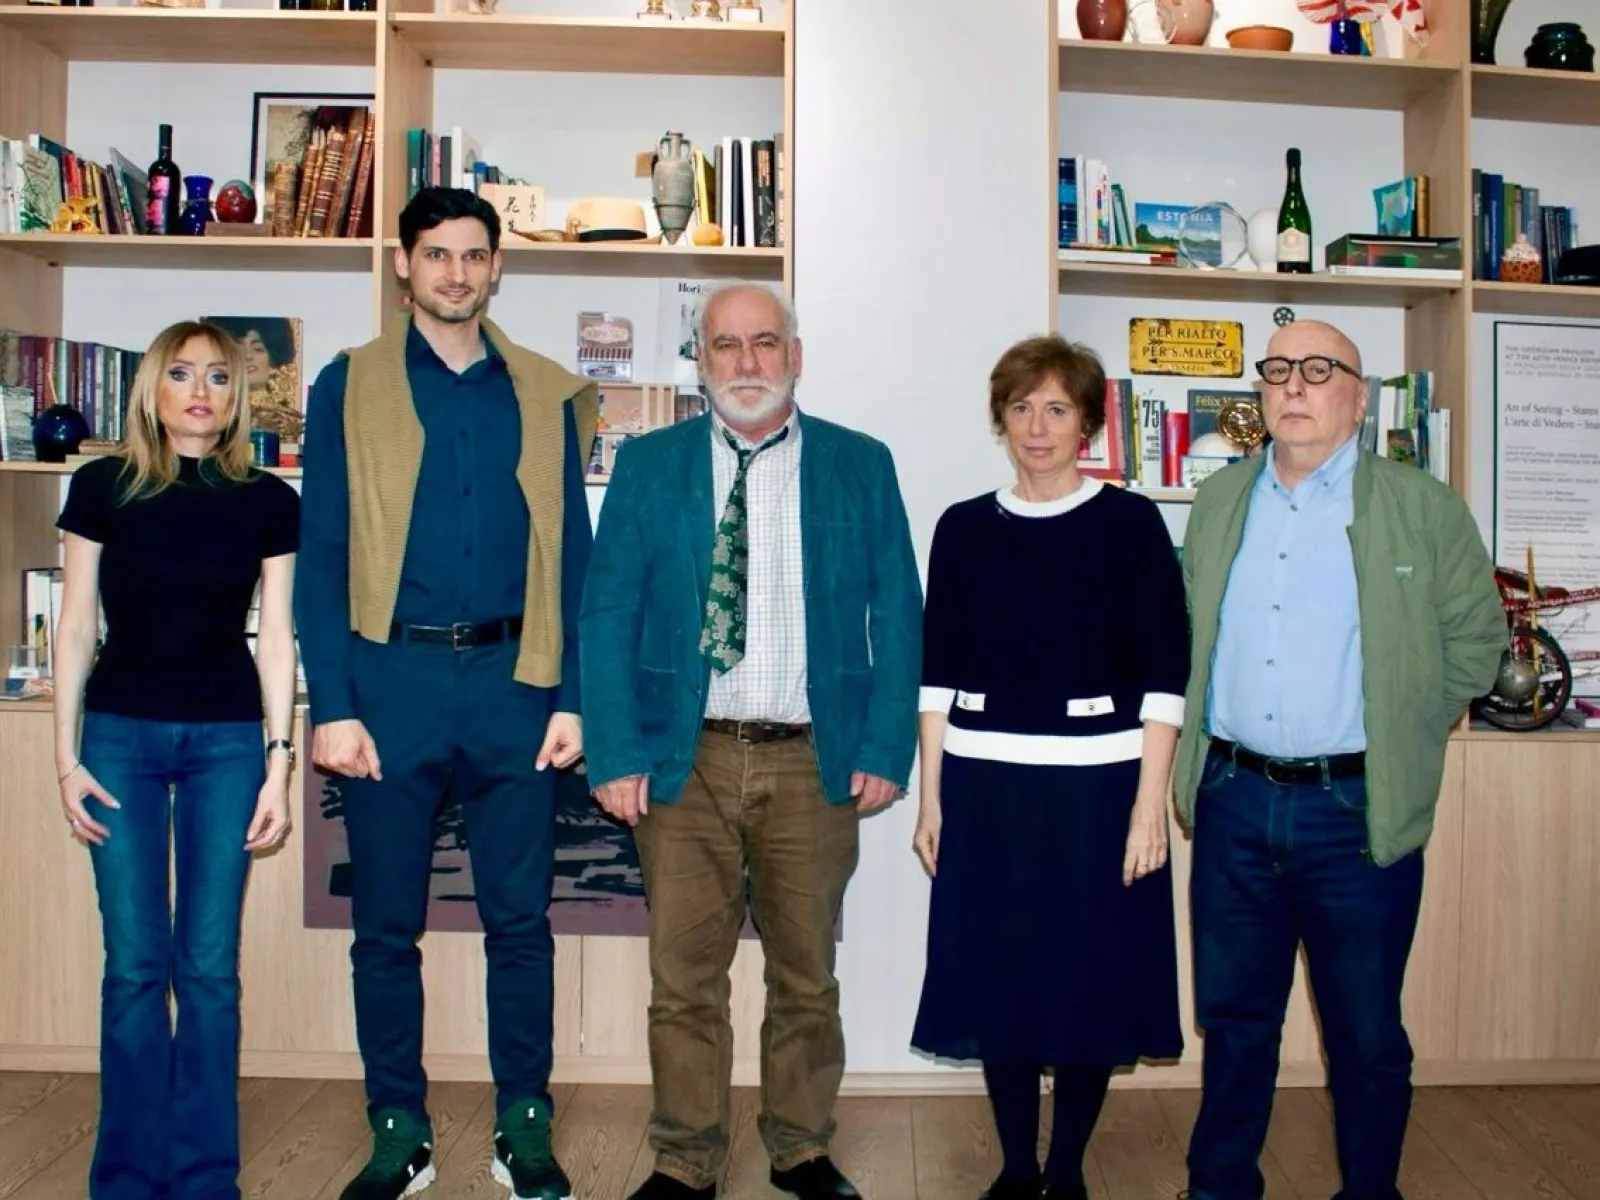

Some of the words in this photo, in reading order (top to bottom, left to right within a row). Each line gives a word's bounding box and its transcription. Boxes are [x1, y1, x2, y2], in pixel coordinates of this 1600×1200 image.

[678, 281, 701, 293] Hori
[1148, 327, 1173, 338] PER
[1178, 328, 1227, 339] RIALTO
[1142, 346, 1168, 357] PER
[1505, 403, 1519, 412] Art
[1521, 401, 1532, 412] of
[1142, 400, 1160, 428] 75
[1532, 418, 1541, 427] di
